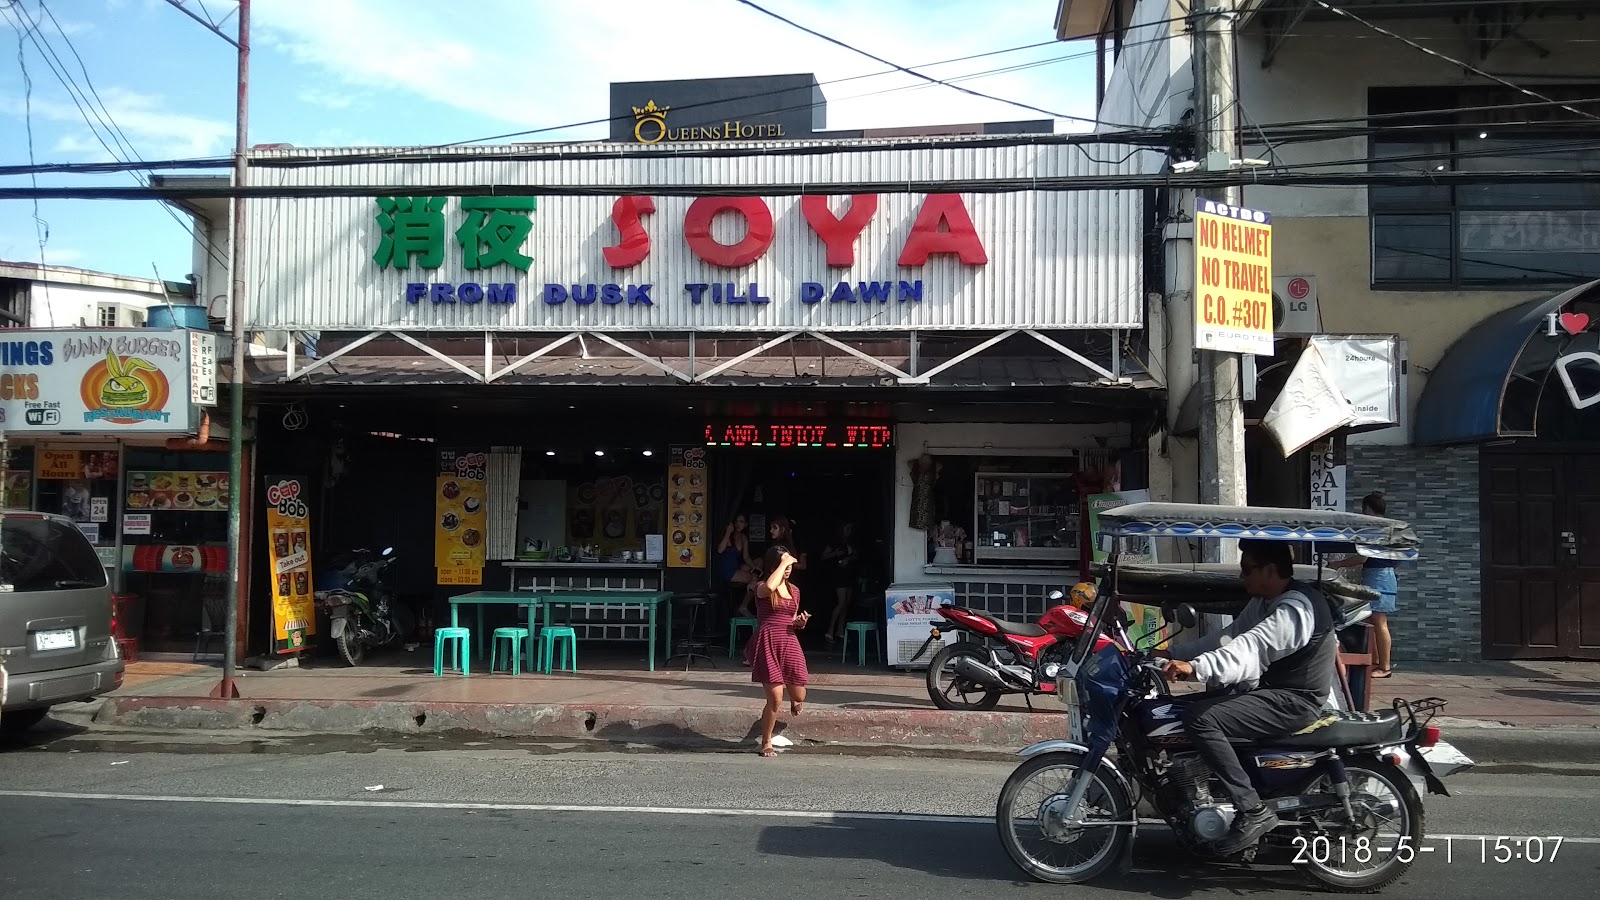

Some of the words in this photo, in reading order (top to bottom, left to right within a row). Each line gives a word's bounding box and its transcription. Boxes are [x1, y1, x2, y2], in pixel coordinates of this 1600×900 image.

[724, 120, 786, 139] HOTEL
[374, 195, 537, 272] 消夜
[602, 193, 990, 268] SOYA
[1200, 217, 1219, 250] NO
[1222, 221, 1270, 258] HELMET
[1201, 256, 1220, 288] NO
[1224, 260, 1270, 295] TRAVEL
[406, 282, 516, 305] FROM
[544, 282, 656, 306] DUSK
[685, 282, 771, 305] TILL
[802, 279, 923, 304] DAWN
[1203, 294, 1230, 326] C.O.
[1232, 298, 1267, 330] #307
[1290, 301, 1308, 312] LG
[1546, 311, 1559, 337] I
[115, 336, 182, 362] BURGER
[1218, 331, 1272, 343] EUROTEL
[0, 341, 54, 366] INGS
[25, 401, 42, 409] Free
[44, 401, 61, 409] Fast
[84, 406, 171, 423] RESTAURANT
[44, 452, 74, 463] Open
[42, 469, 76, 478] Hours
[1311, 454, 1322, 510] 어서오세
[1321, 452, 1339, 512] SAL
[93, 506, 105, 515] 24
[279, 557, 294, 569] Take
[293, 553, 306, 564] out
